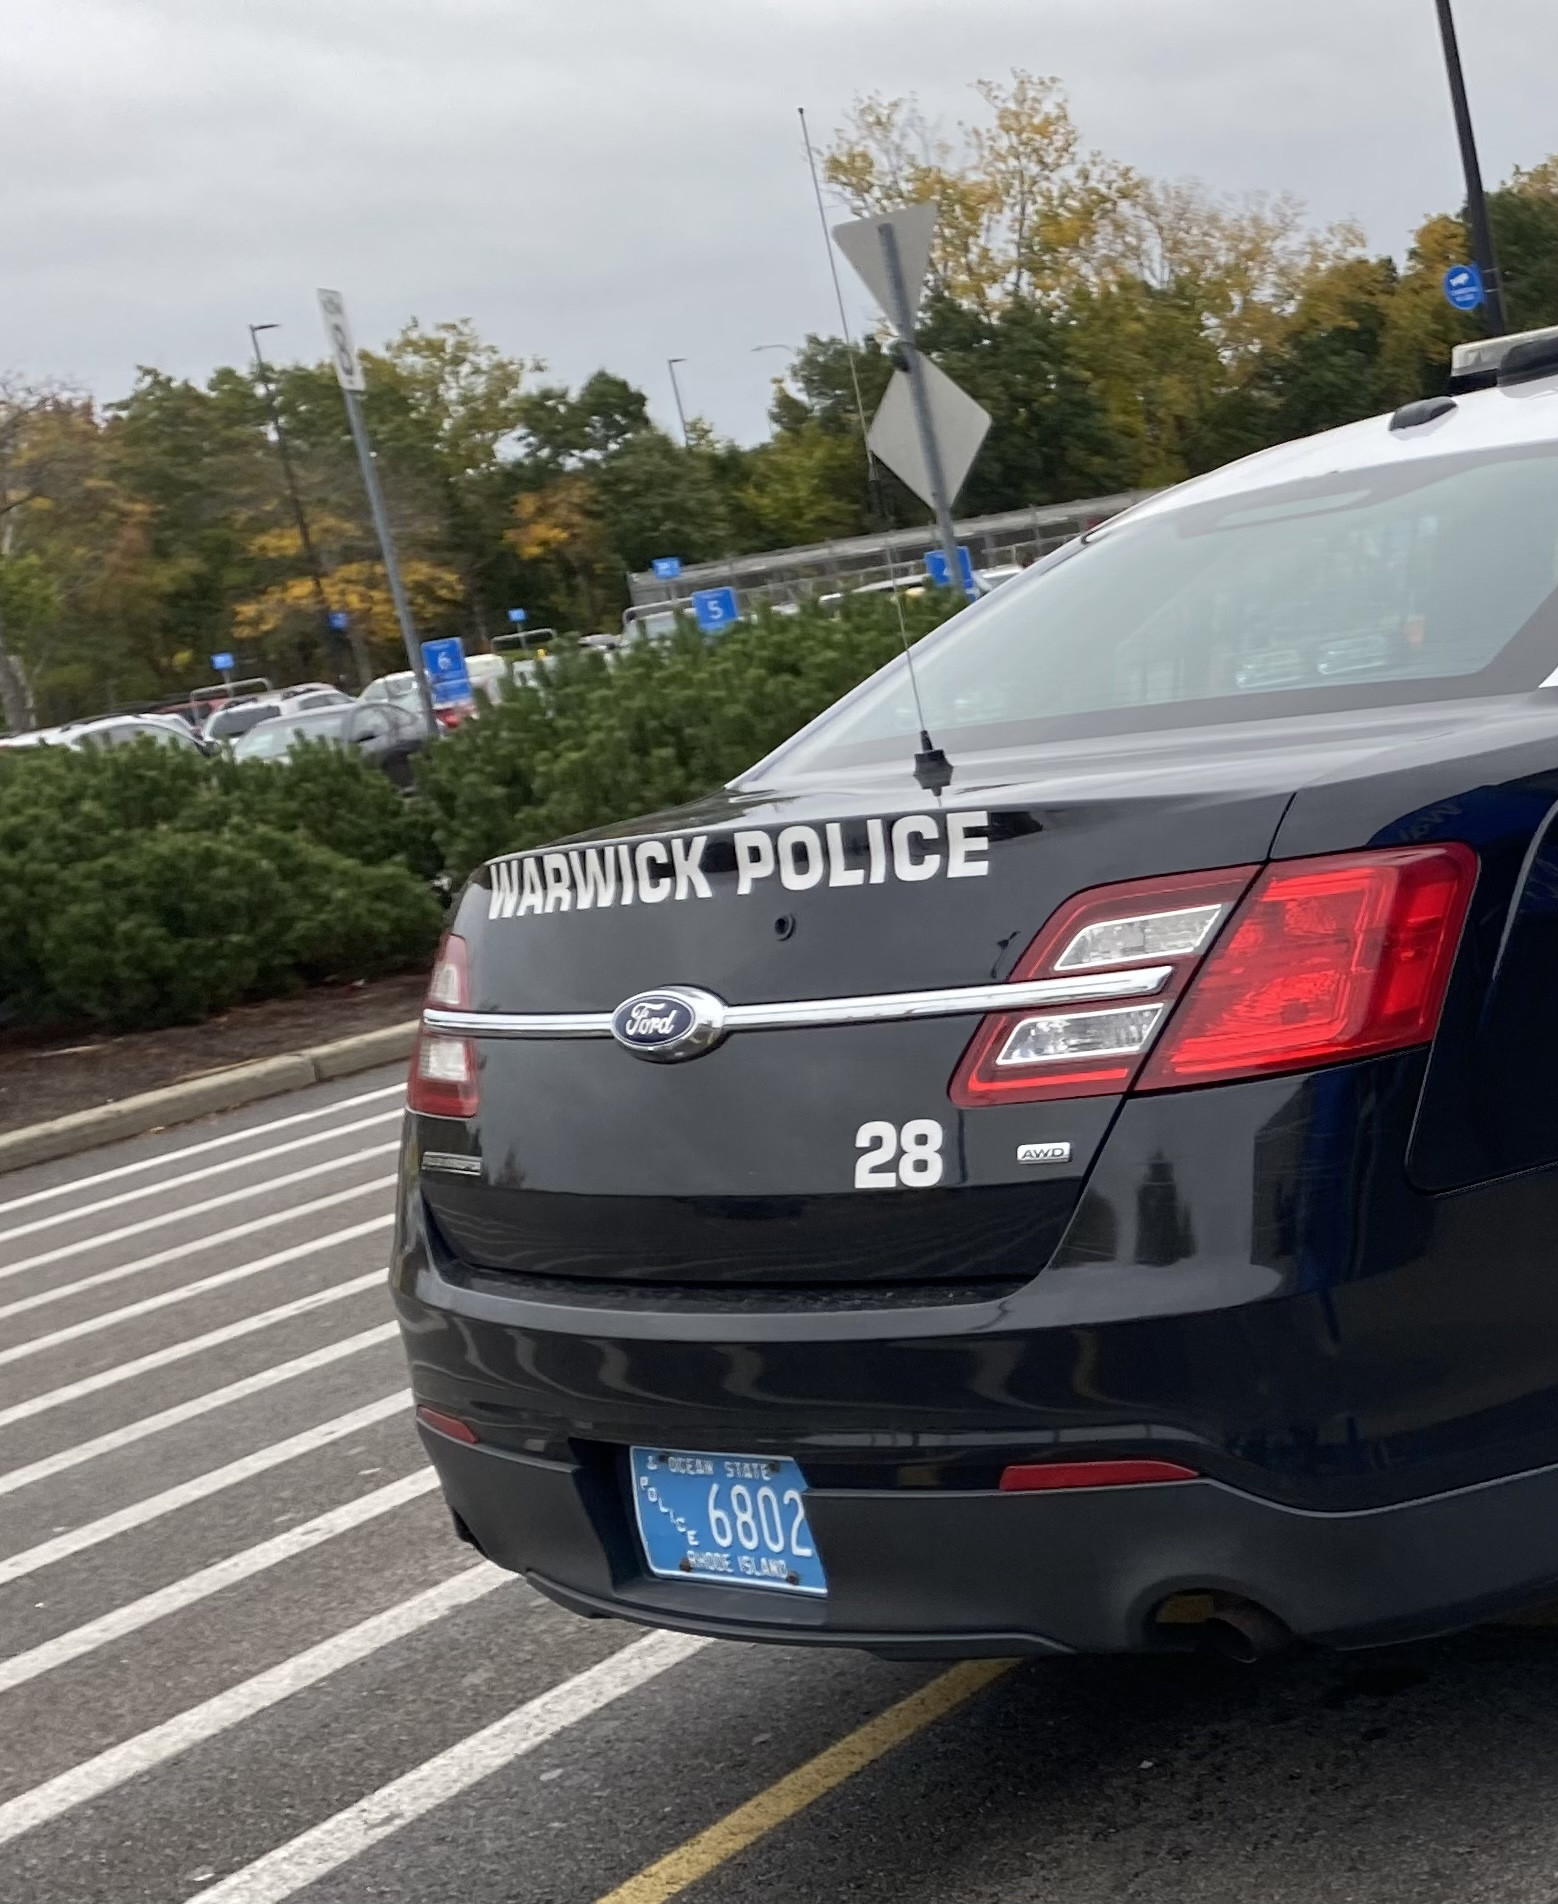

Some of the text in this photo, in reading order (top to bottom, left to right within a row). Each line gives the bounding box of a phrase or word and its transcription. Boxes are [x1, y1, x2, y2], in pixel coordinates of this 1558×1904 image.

[707, 600, 724, 619] 5
[488, 810, 990, 920] WARWICK POLICE
[625, 1002, 678, 1036] Ford
[854, 1118, 944, 1190] 28
[1021, 1147, 1065, 1160] AWD
[668, 1456, 772, 1481] OCEAN STATE
[707, 1482, 813, 1558] 6802
[686, 1550, 788, 1578] RHODE ISLAND
